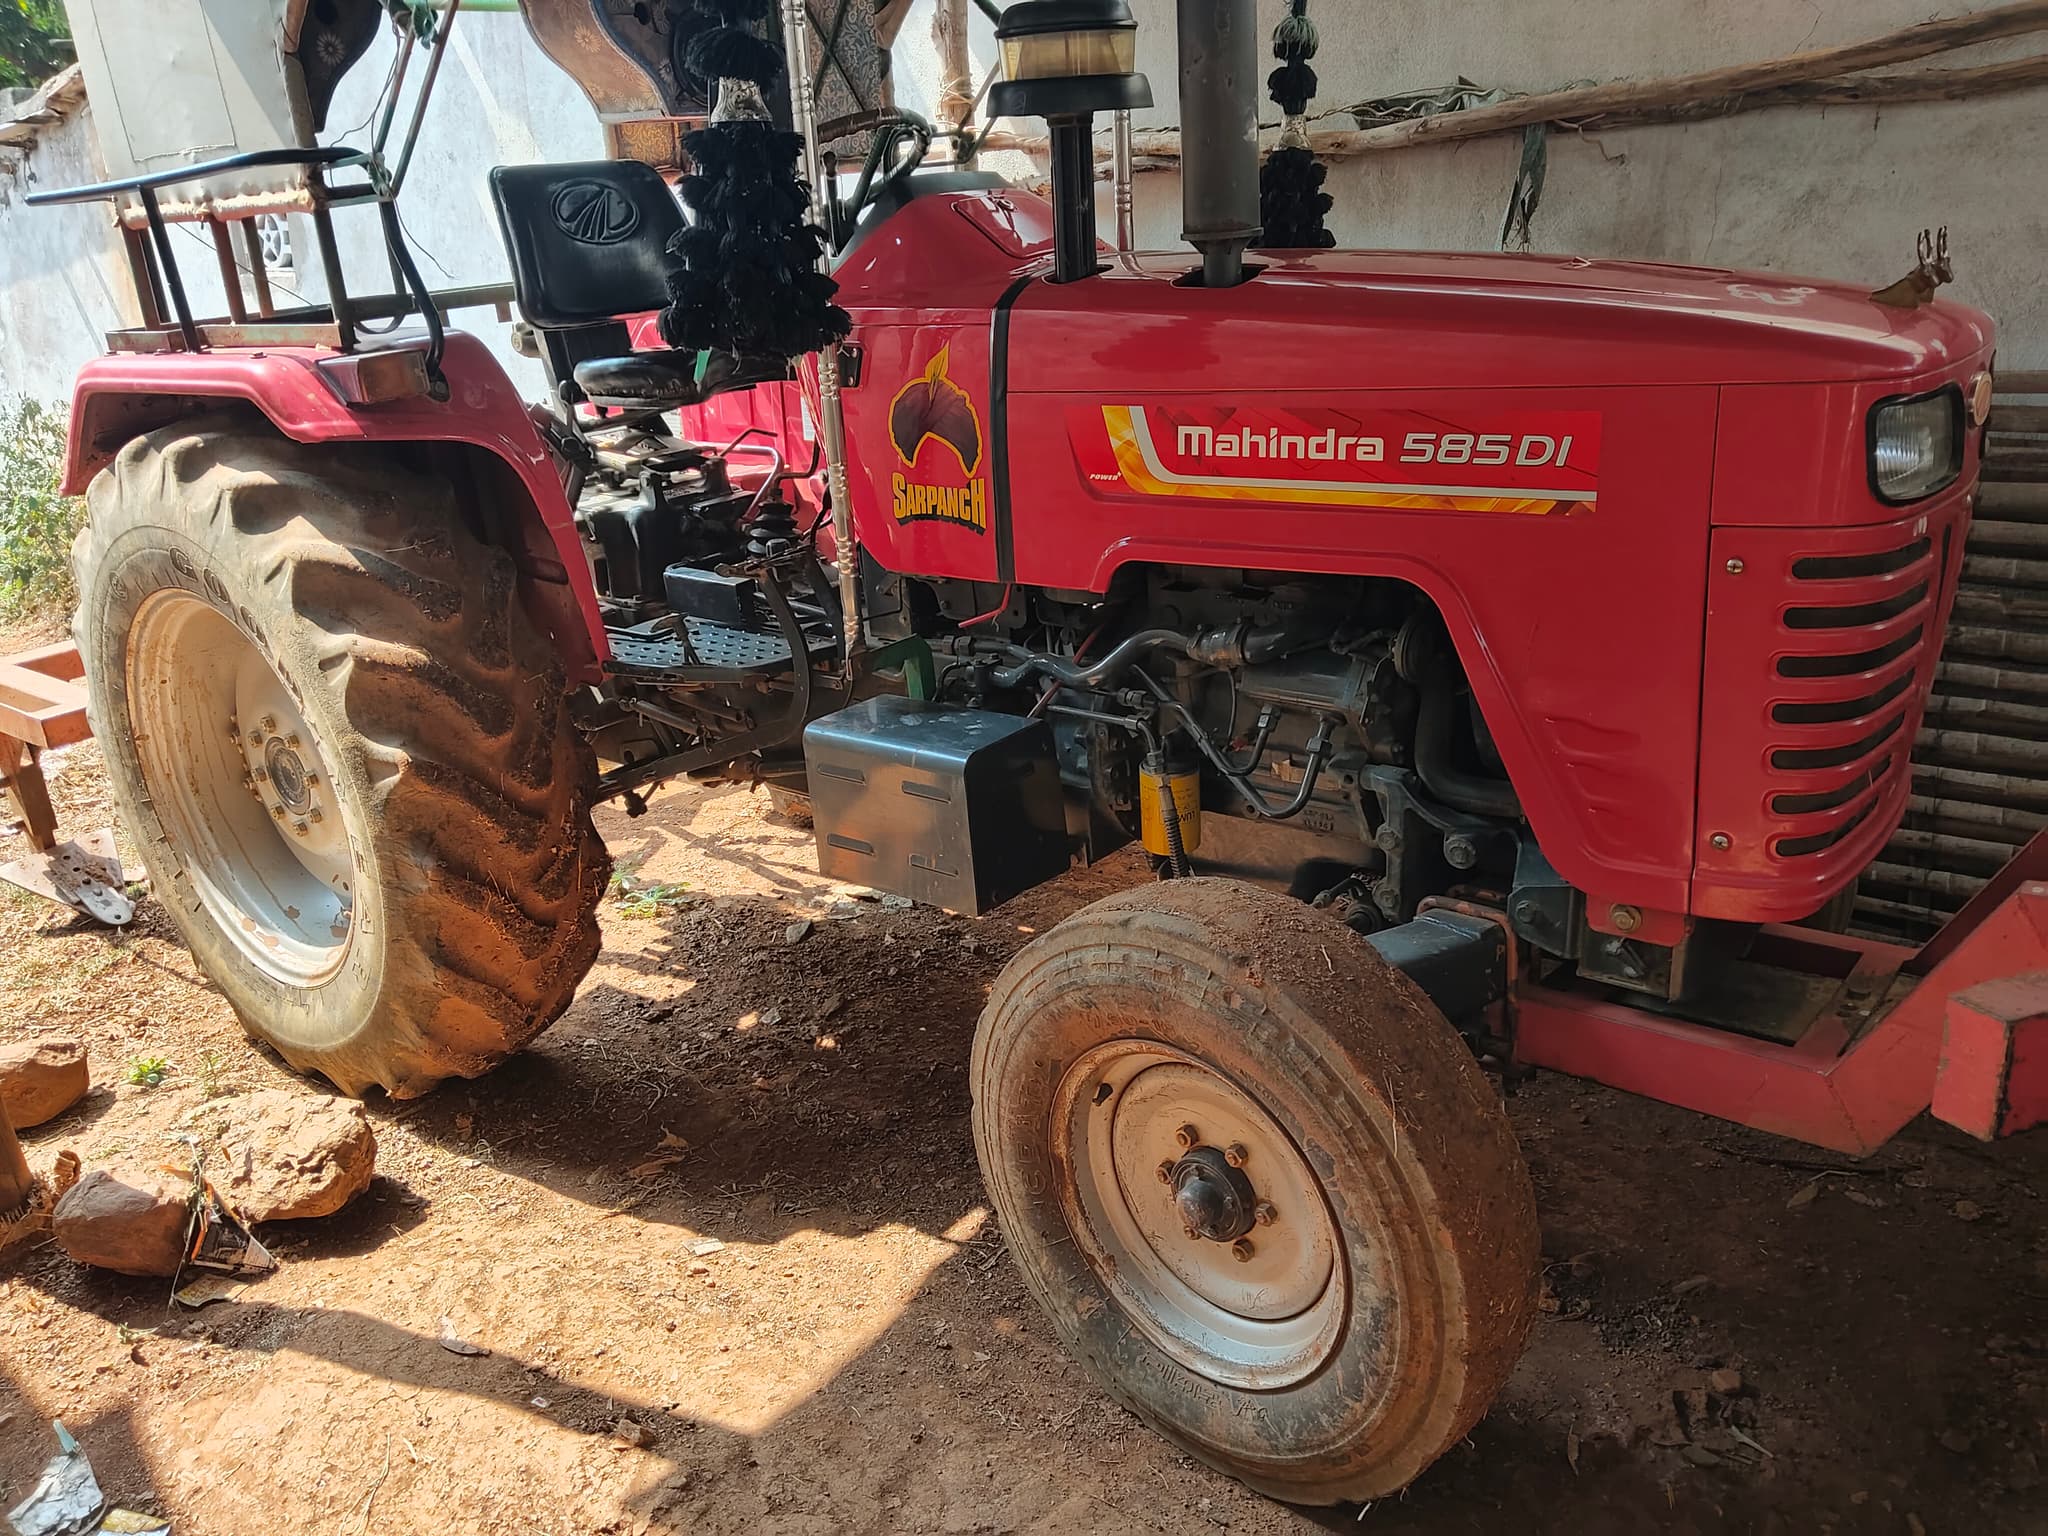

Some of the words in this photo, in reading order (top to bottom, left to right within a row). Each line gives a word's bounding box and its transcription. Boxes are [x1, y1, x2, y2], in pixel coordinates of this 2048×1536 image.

[1177, 425, 1384, 463] Mahindra
[1399, 432, 1513, 466] 585
[1516, 434, 1575, 467] DI
